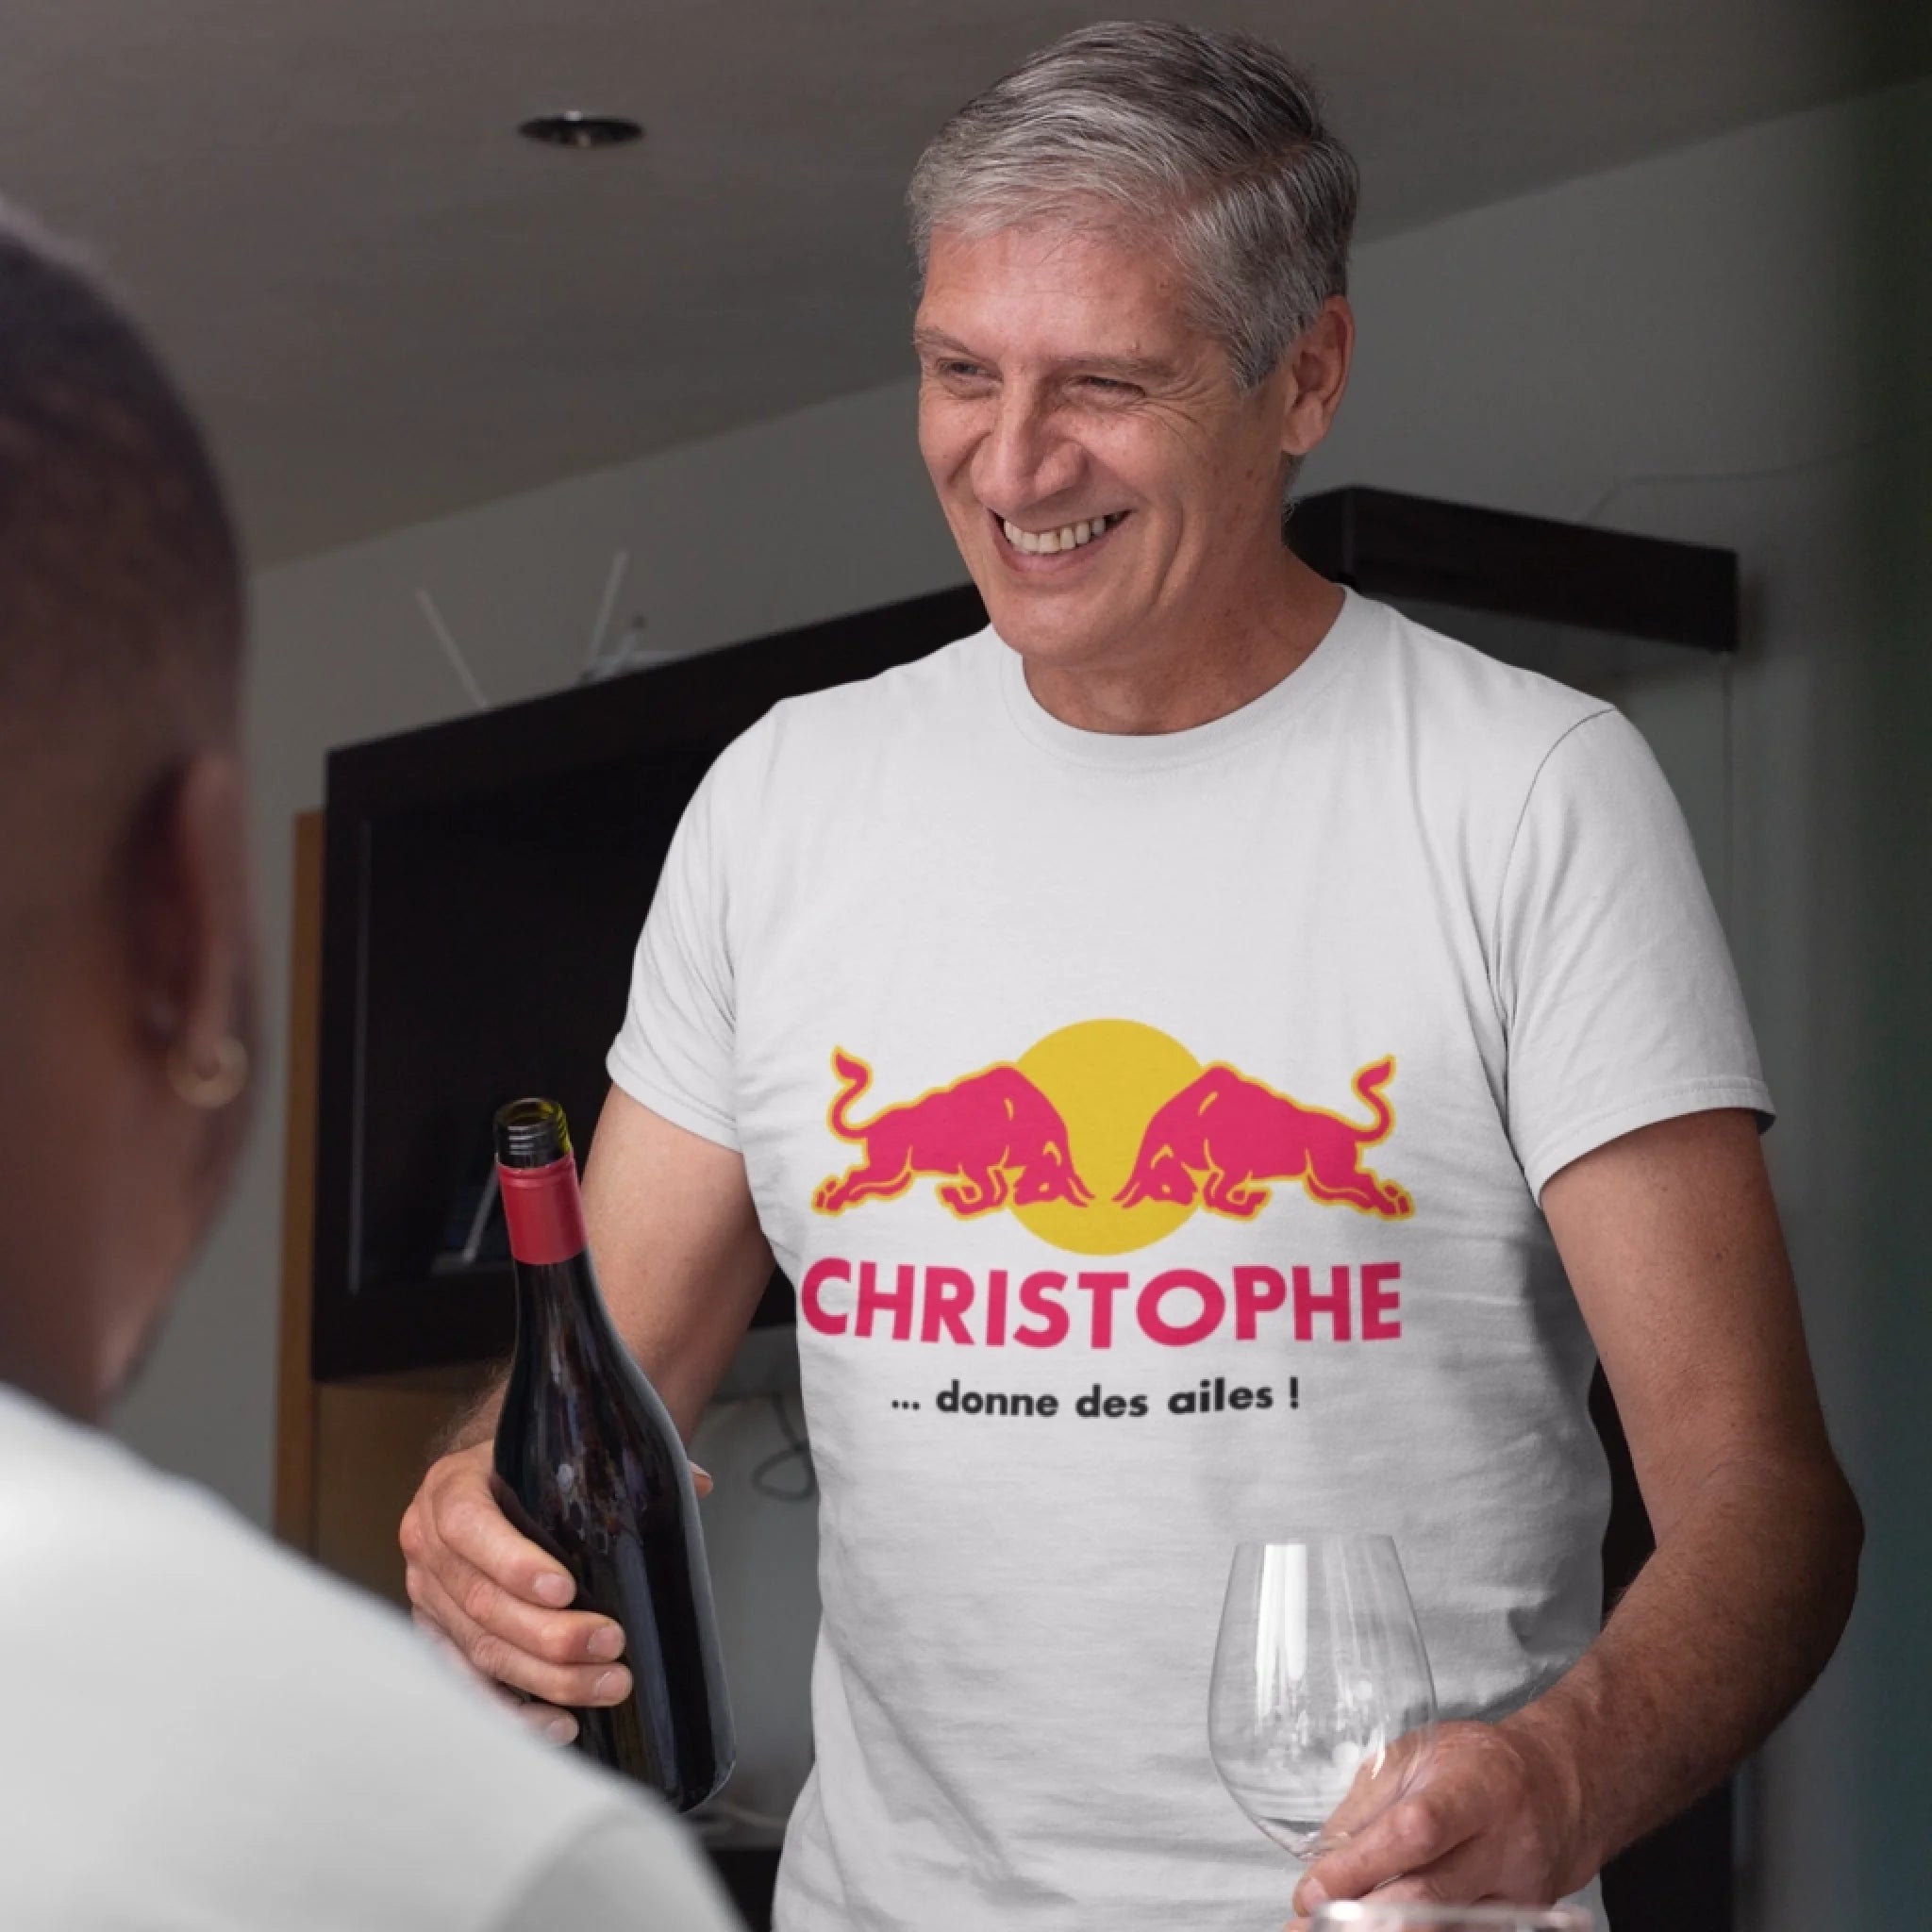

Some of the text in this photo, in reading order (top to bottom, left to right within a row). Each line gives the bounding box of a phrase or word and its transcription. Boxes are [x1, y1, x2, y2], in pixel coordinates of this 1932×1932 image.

[800, 1256, 1403, 1350] CHRISTOPHE
[936, 1377, 1060, 1419] donne
[1074, 1383, 1149, 1419] des
[1166, 1375, 1274, 1414] ailes
